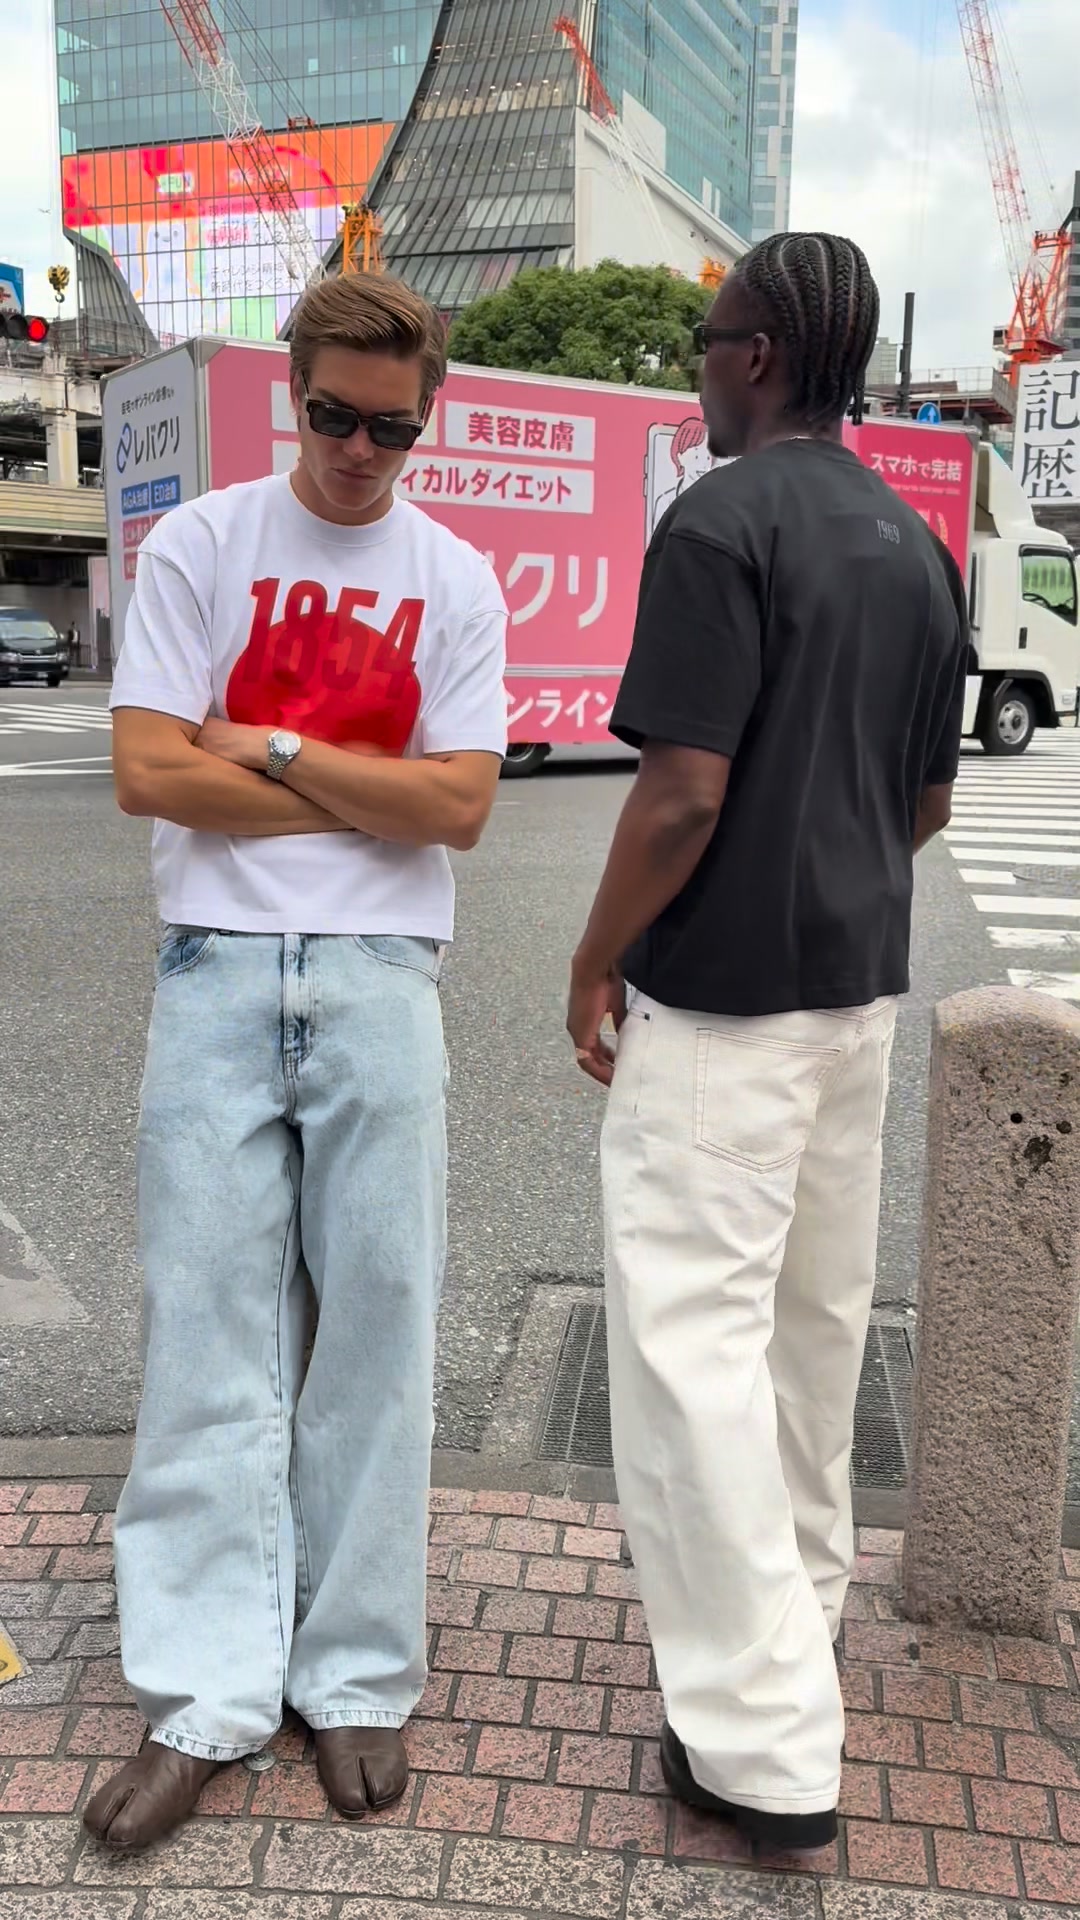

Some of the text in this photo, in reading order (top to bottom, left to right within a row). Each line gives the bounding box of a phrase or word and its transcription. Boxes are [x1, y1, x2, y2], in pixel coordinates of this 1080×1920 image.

[133, 415, 181, 466] レバクリ
[468, 411, 576, 453] 美容皮膚
[401, 454, 572, 505] ィカルダイエット
[870, 453, 964, 482] スマホで完結
[876, 519, 901, 545] 1969
[486, 550, 609, 630] クリ
[243, 577, 426, 700] 1854
